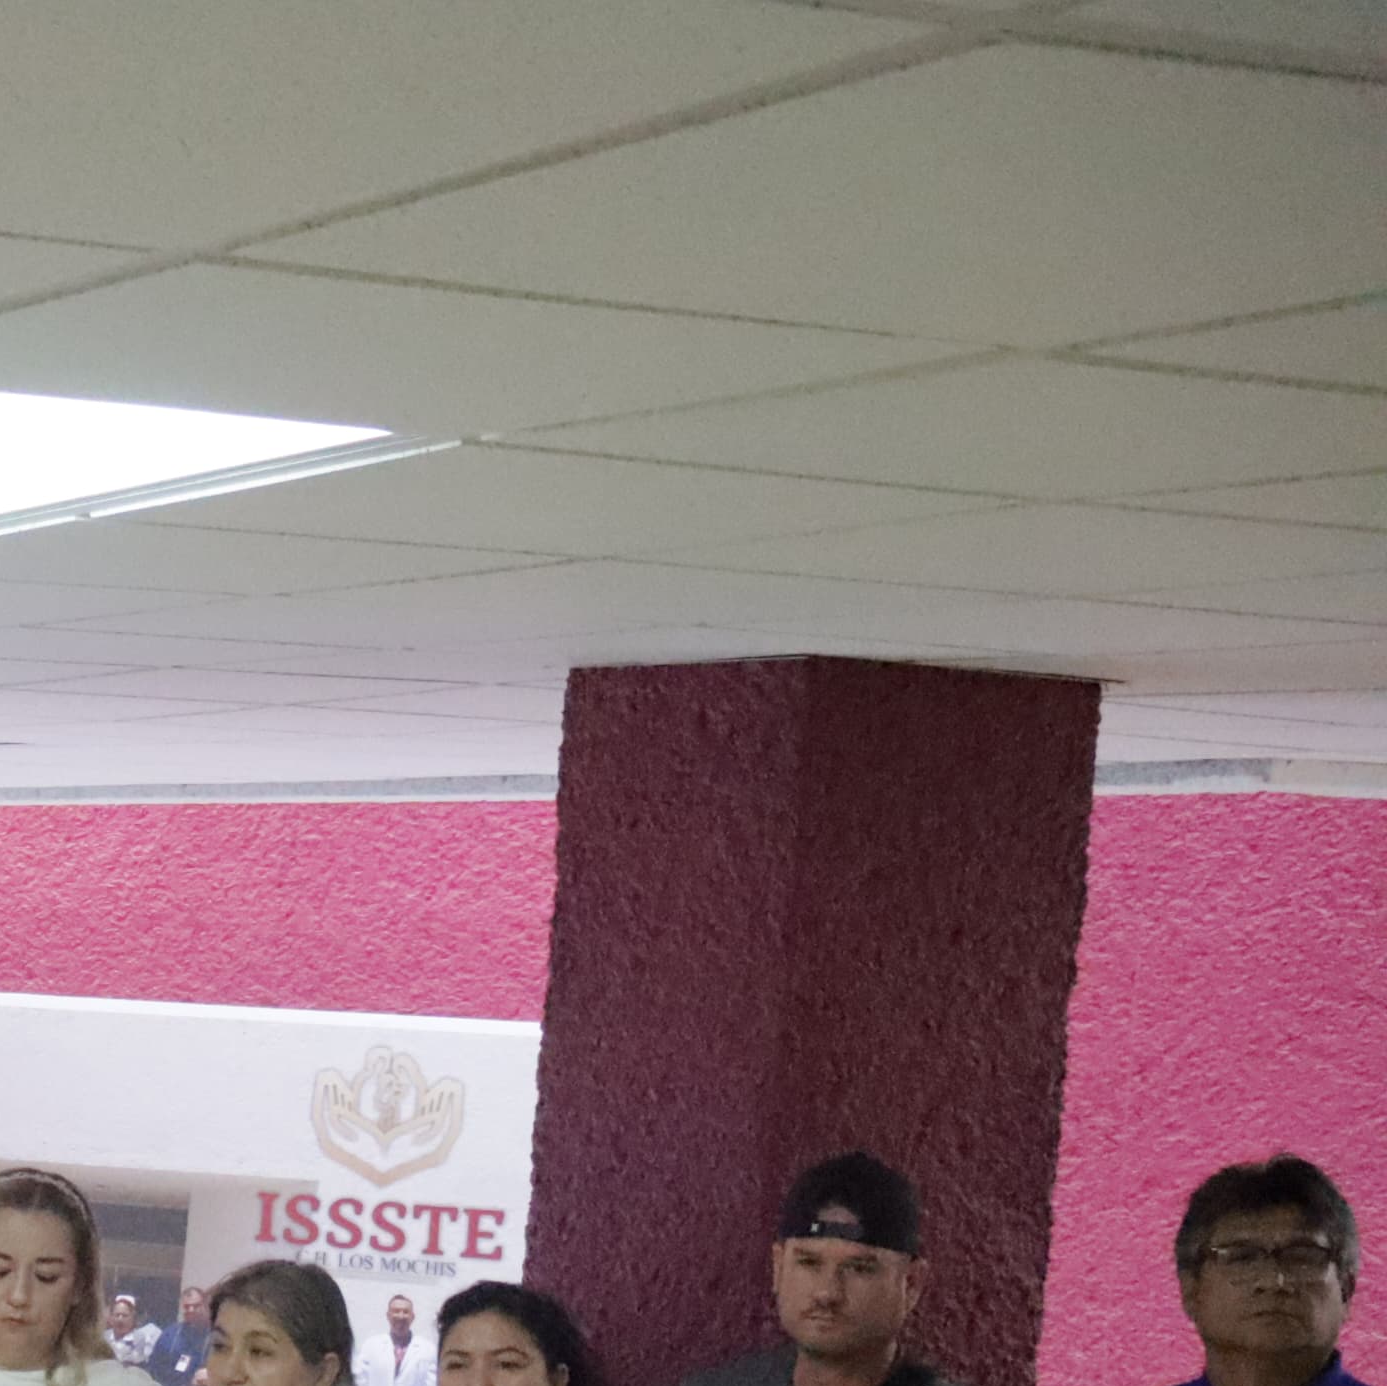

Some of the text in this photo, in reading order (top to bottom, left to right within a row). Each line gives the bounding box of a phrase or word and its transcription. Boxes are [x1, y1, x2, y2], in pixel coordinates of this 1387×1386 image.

[255, 1192, 505, 1260] ISSSTE
[338, 1252, 373, 1270] LOS
[380, 1256, 456, 1278] MOCHIS
